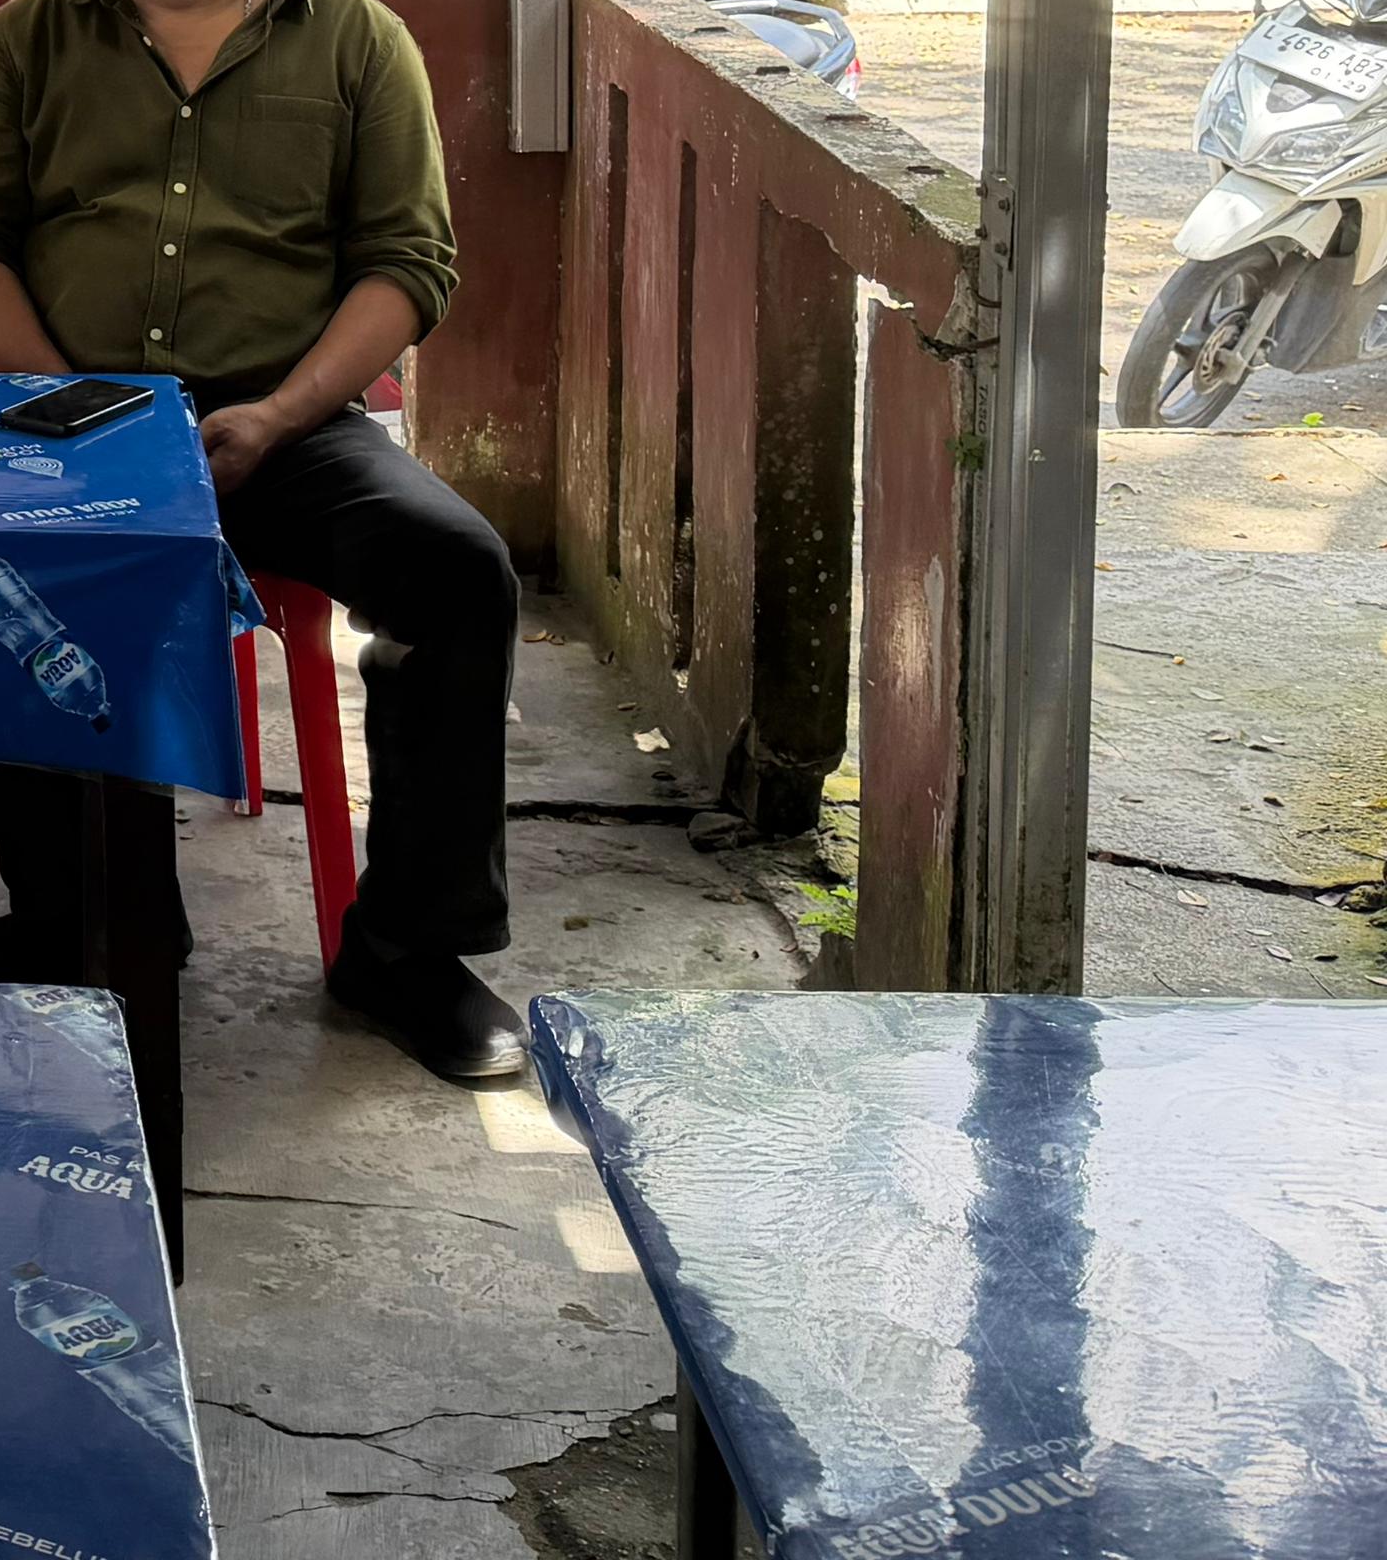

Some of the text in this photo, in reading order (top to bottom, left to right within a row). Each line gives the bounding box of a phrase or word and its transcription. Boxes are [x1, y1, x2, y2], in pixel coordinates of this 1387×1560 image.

[1, 497, 141, 522] AQUA DULU
[39, 647, 82, 686] AQUA
[68, 1145, 123, 1167] PAS
[17, 1153, 135, 1201] AQUA
[51, 1313, 130, 1350] AQUA
[960, 1464, 1098, 1528] DULU
